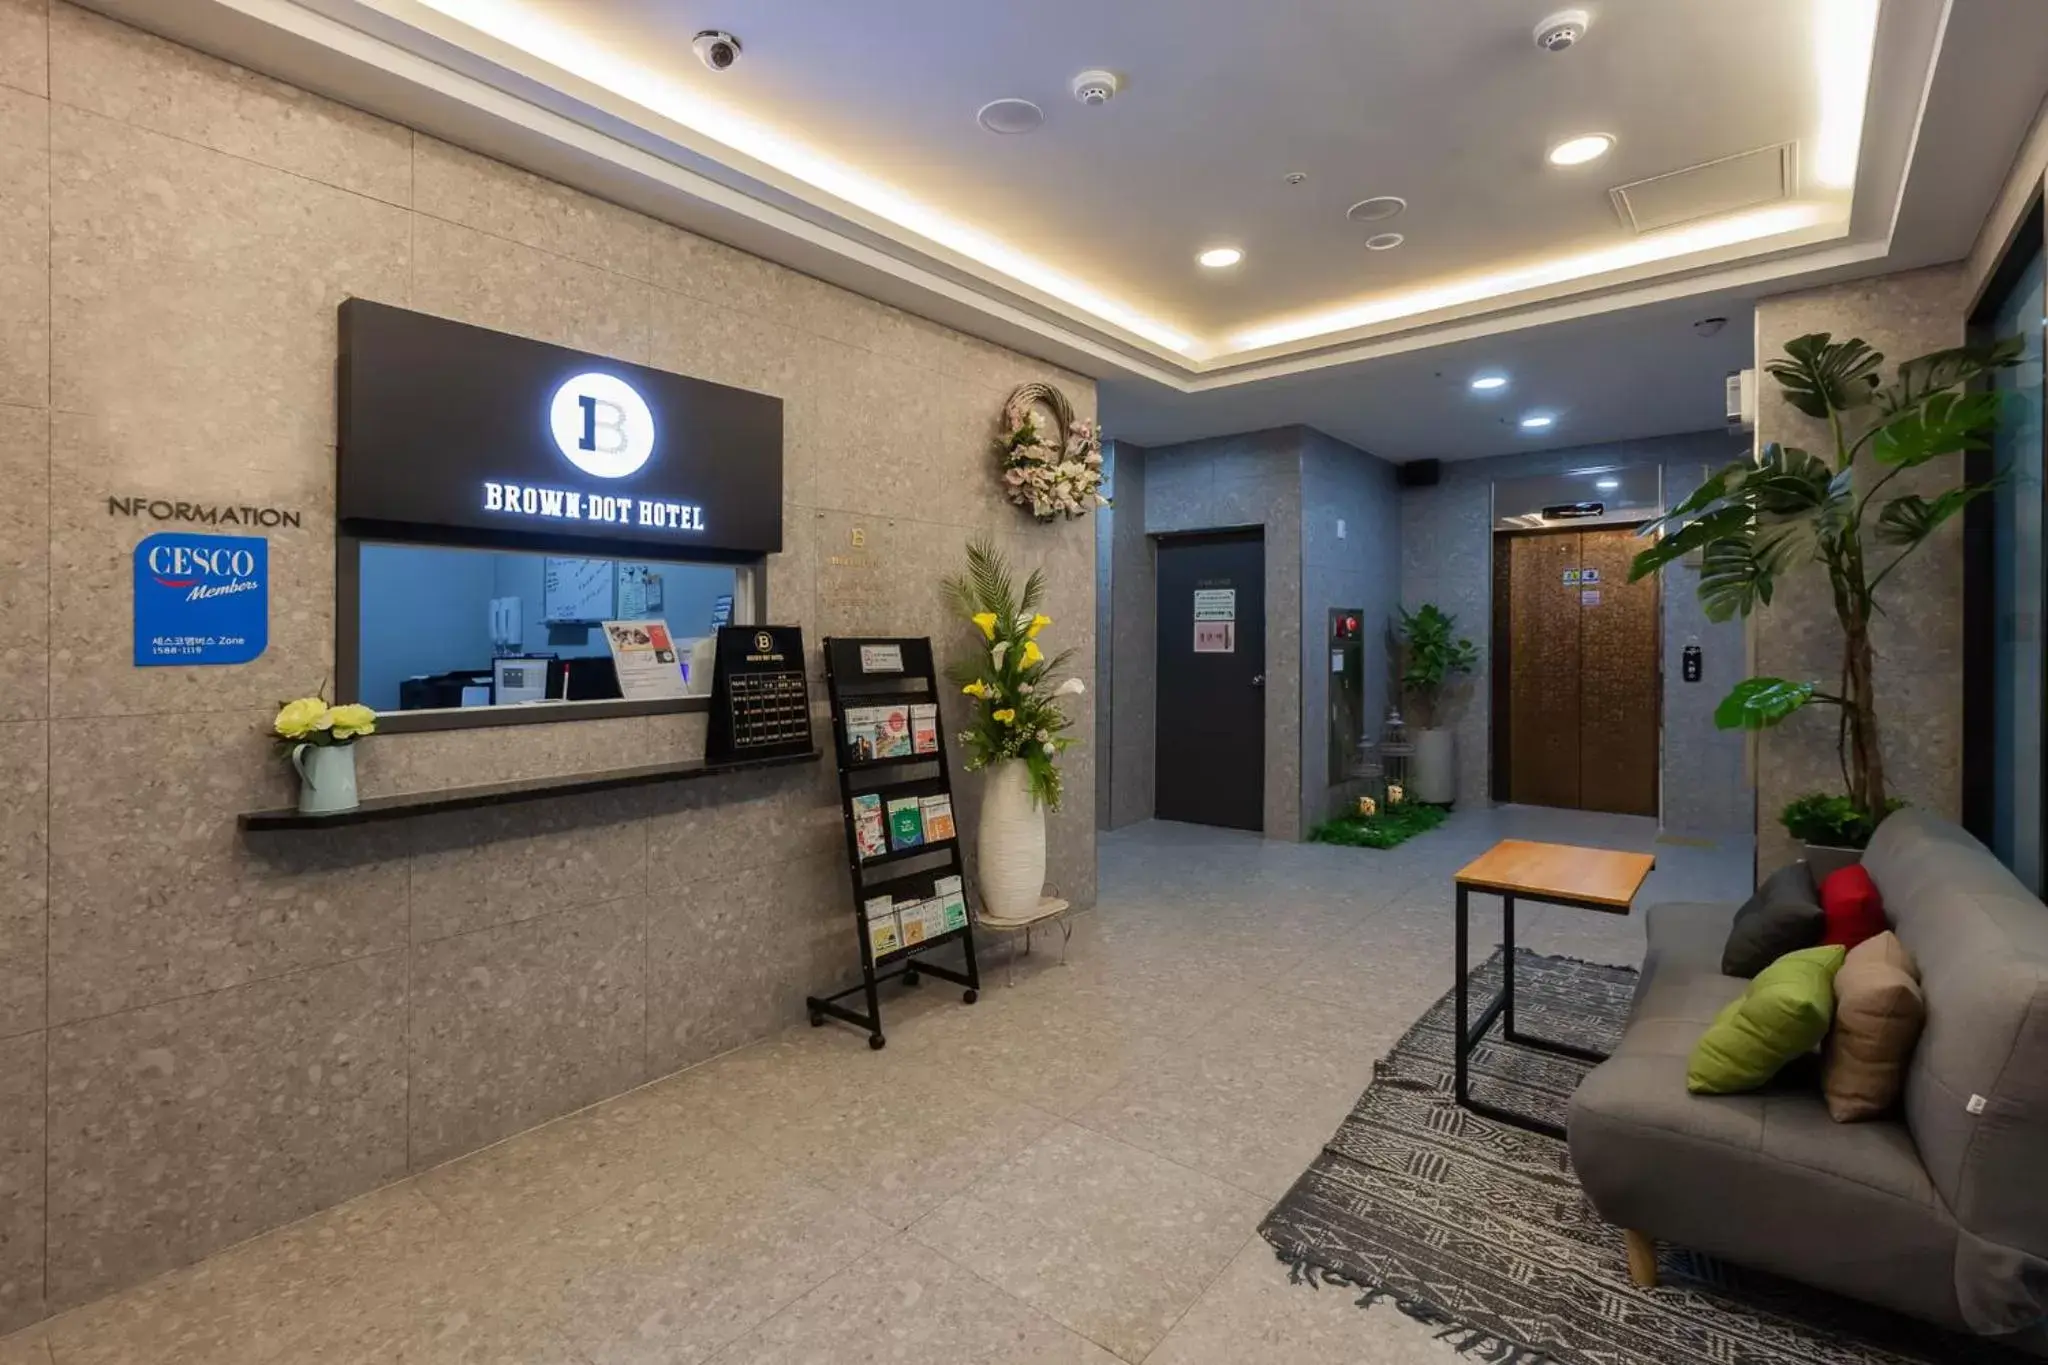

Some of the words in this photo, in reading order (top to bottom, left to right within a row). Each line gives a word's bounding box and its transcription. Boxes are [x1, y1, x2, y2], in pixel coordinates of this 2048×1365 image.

[108, 496, 301, 529] NFORMATION
[638, 500, 705, 531] HOTEL
[149, 545, 255, 577] CESCO
[185, 577, 259, 603] Members
[218, 636, 246, 646] Zone
